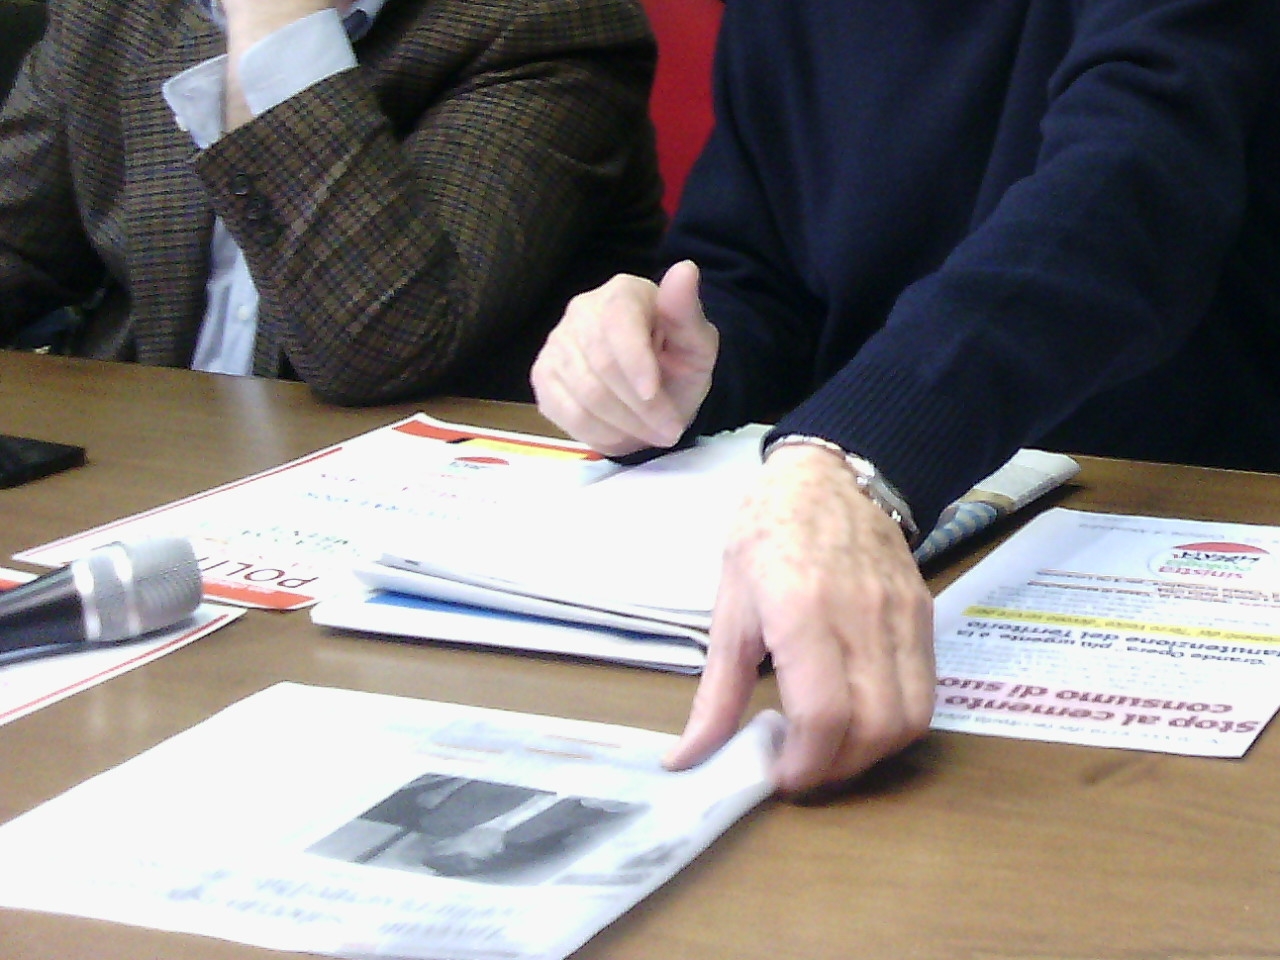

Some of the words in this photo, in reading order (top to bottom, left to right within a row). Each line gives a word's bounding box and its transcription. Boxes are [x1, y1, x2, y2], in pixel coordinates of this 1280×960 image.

[966, 620, 1072, 639] Territorio
[1080, 630, 1120, 641] del
[1007, 683, 1048, 699] di
[944, 693, 1116, 721] cemento
[1055, 689, 1233, 714] consumo
[1121, 712, 1161, 727] al
[1168, 715, 1262, 734] Stop
